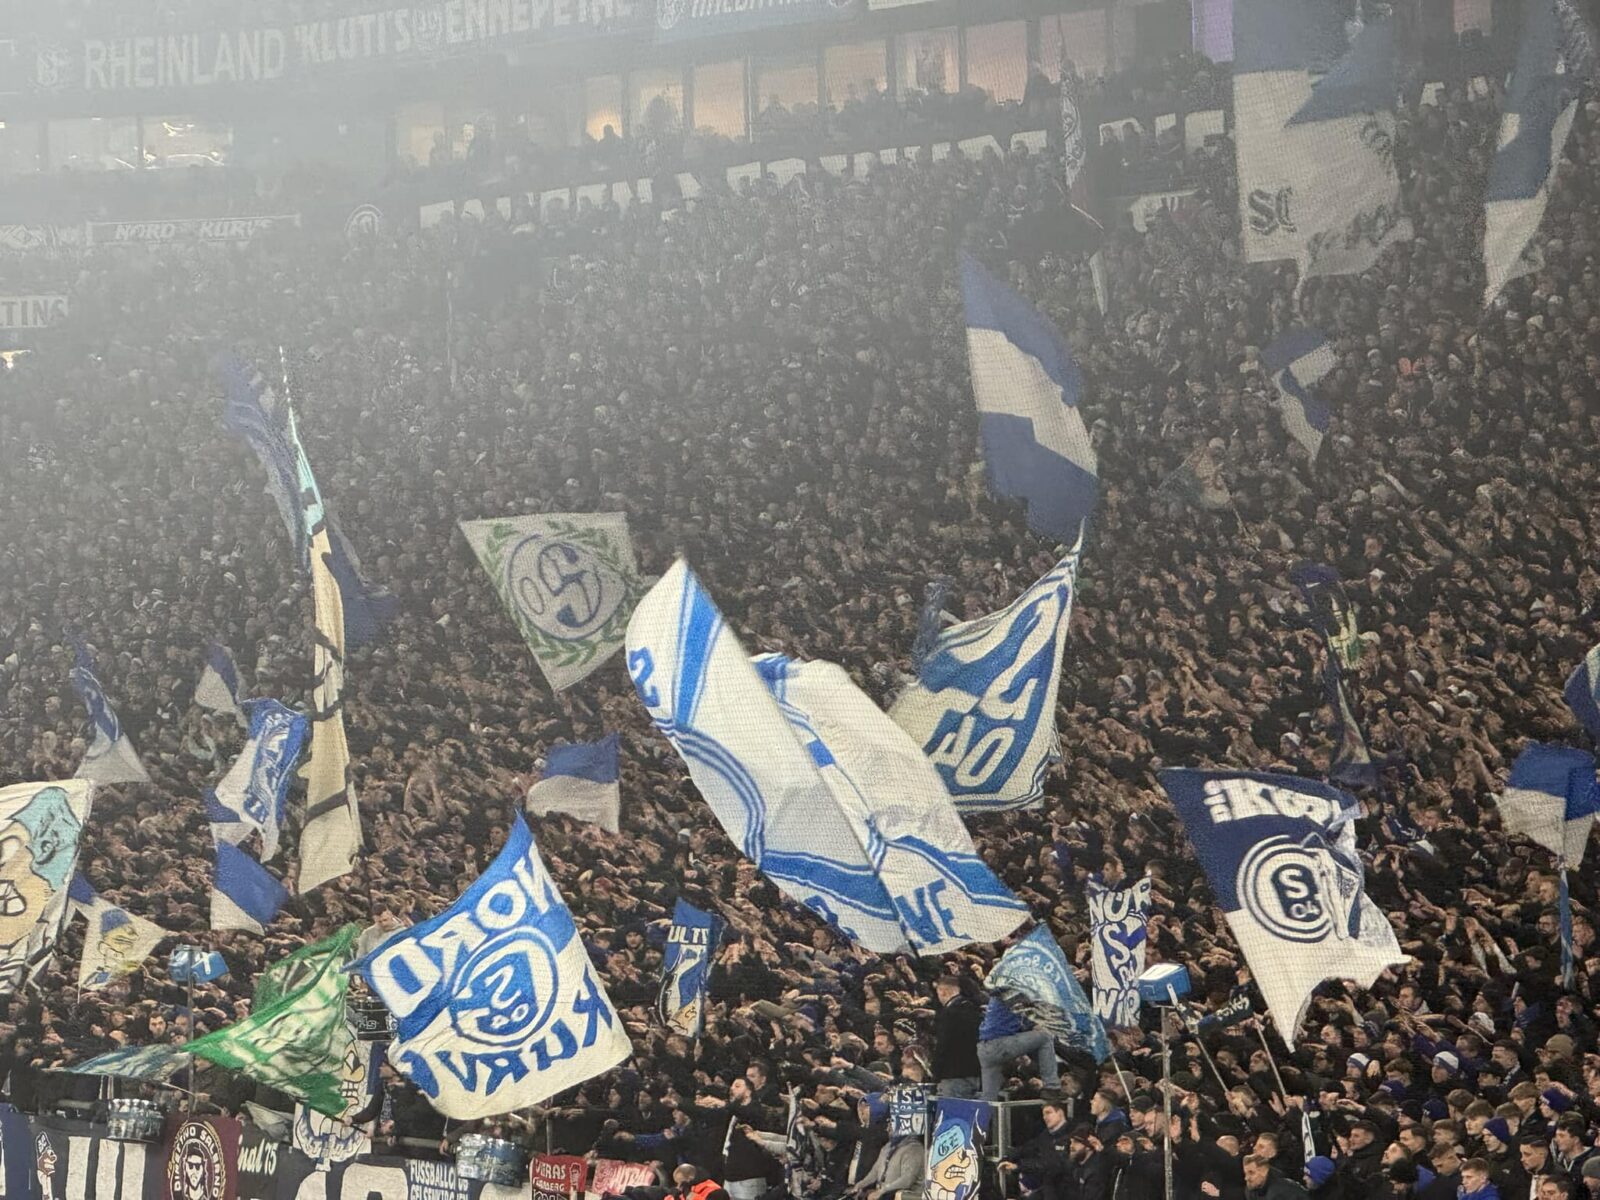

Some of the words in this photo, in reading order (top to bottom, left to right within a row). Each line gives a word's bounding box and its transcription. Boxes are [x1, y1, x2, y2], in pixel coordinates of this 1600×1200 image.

[82, 29, 288, 90] RHEINLAND
[114, 222, 176, 241] NORD
[0, 299, 66, 326] TINS
[1089, 876, 1153, 926] NUR
[264, 1141, 280, 1177] 75
